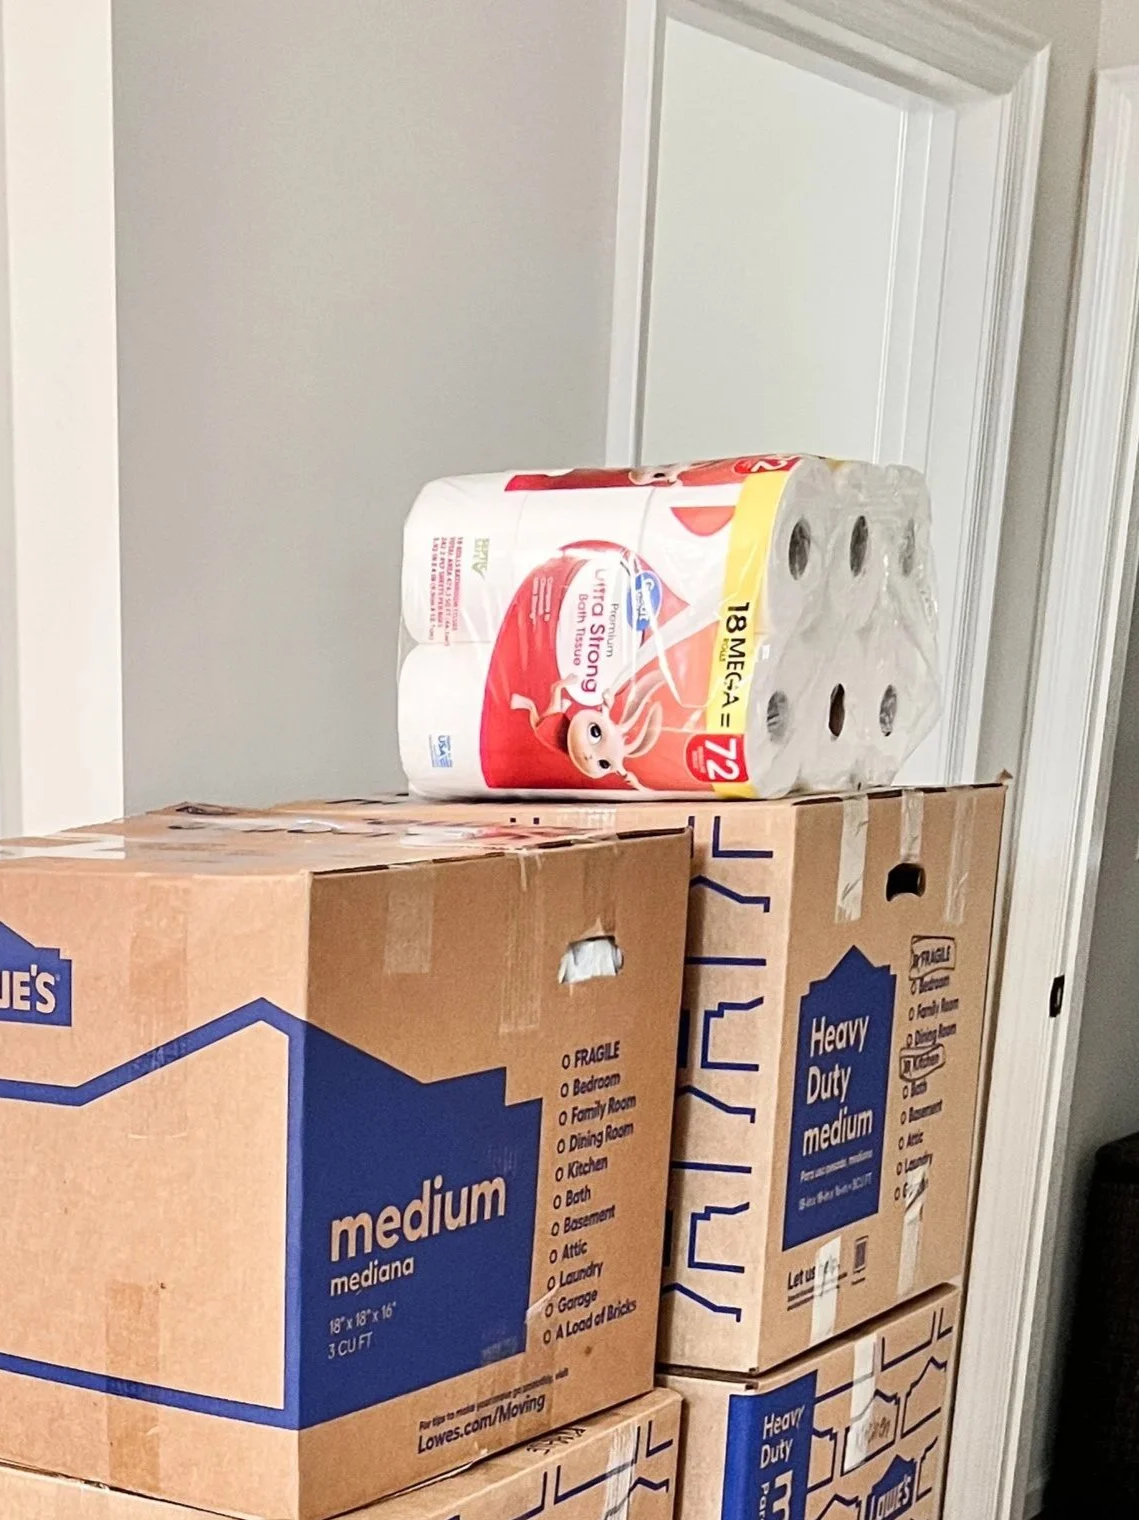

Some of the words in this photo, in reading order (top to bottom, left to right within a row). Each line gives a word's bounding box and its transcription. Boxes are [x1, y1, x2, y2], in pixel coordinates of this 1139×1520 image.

[577, 594, 588, 624] Bath
[726, 602, 750, 634] 18
[573, 628, 585, 666] Tissue
[607, 604, 618, 658] Premium
[581, 624, 605, 693] Strong
[722, 638, 746, 708] MEGA
[705, 739, 740, 781] 72
[810, 1014, 869, 1057] Heavy
[574, 1040, 620, 1068] FRAGILE
[573, 1073, 620, 1096] Bedroom
[807, 1064, 851, 1104] Duty
[571, 1100, 606, 1124] Family
[608, 1096, 636, 1114] Room
[569, 1130, 604, 1152] Dining
[606, 1123, 634, 1142] Room
[802, 1106, 872, 1157] medium
[567, 1156, 608, 1179] Kitchen
[566, 1185, 590, 1207] Bath
[330, 1174, 506, 1262] medium
[564, 1204, 616, 1234] Basement
[562, 1239, 588, 1262] Attic
[330, 1257, 414, 1296] mediana
[560, 1260, 604, 1288] Laundry
[558, 1289, 598, 1314] Garage
[556, 1324, 564, 1340] A
[566, 1312, 592, 1338] Load
[594, 1306, 606, 1326] of
[606, 1298, 637, 1322] Bricks
[328, 1343, 336, 1360] 3
[338, 1338, 356, 1356] CU
[360, 1331, 374, 1348] FT
[418, 1394, 546, 1454] Lowes.com/Moving
[762, 1405, 805, 1440] Heavy
[760, 1438, 794, 1469] Duty
